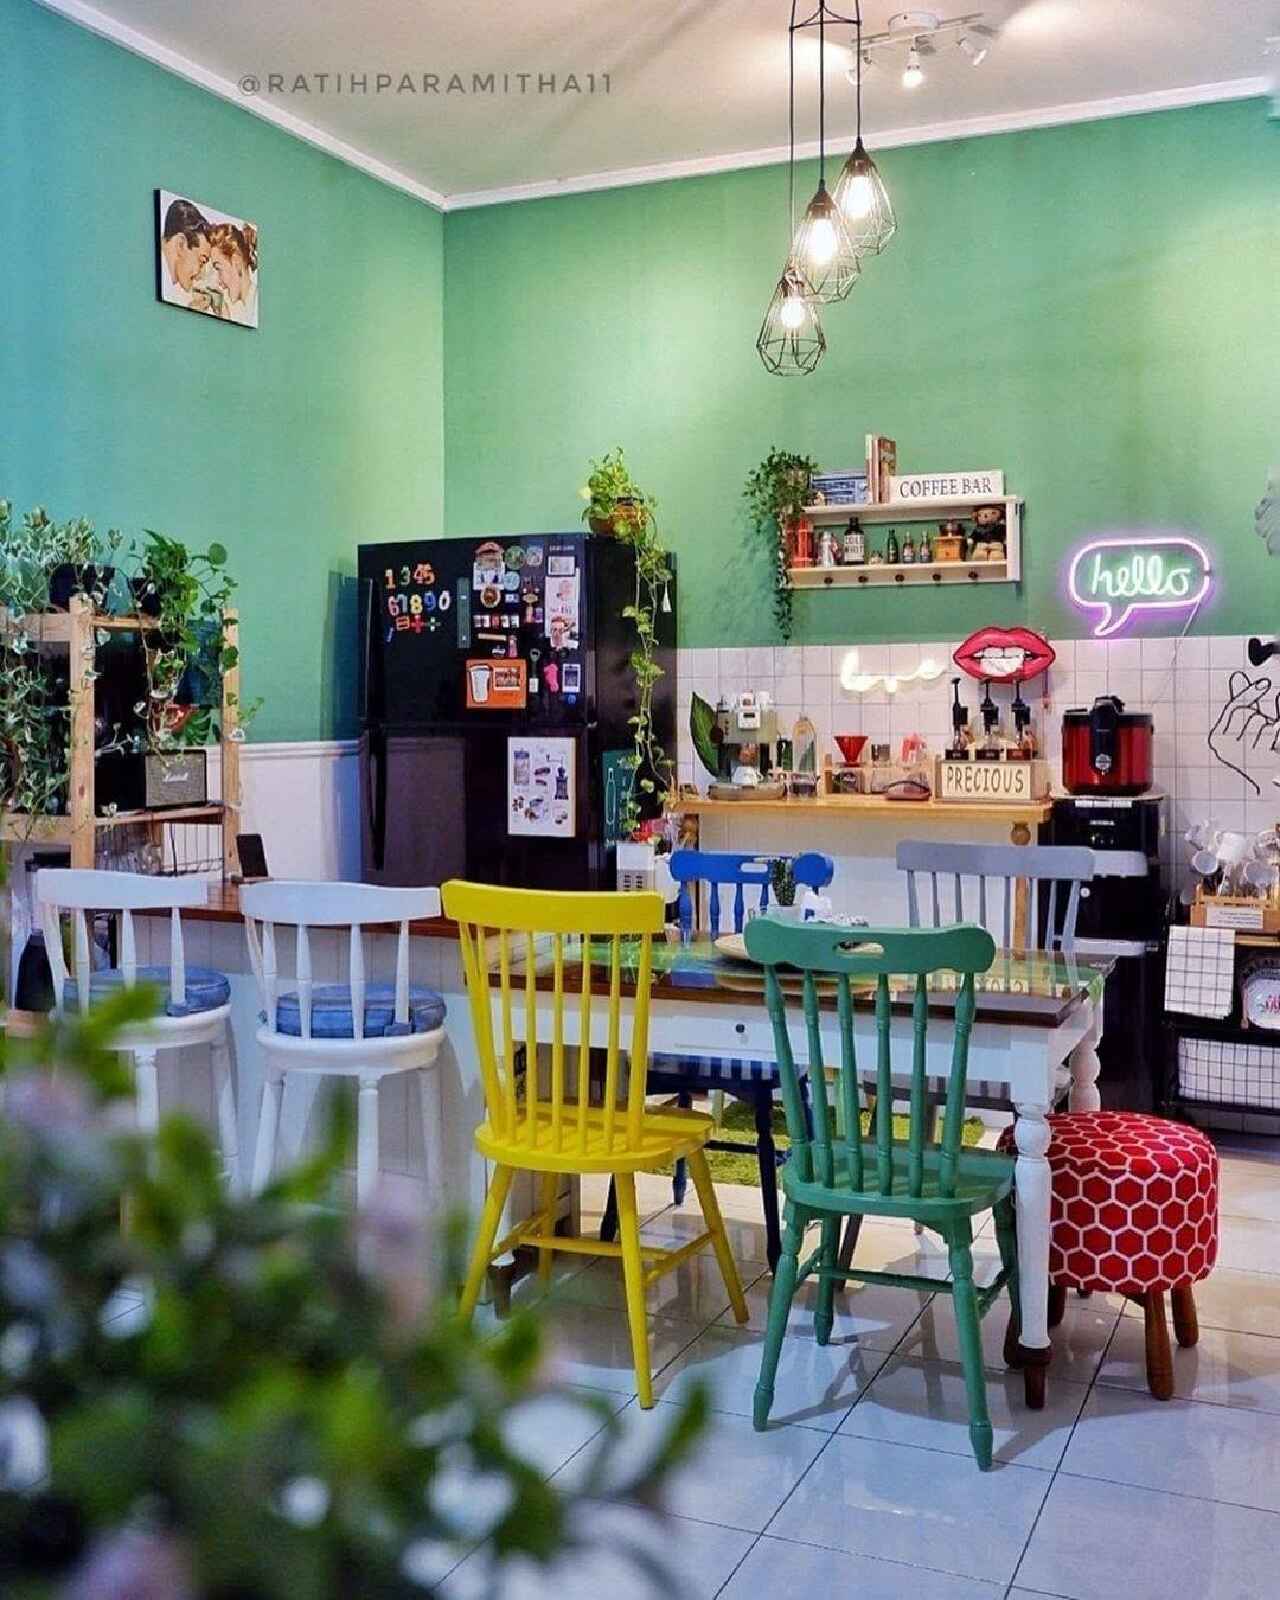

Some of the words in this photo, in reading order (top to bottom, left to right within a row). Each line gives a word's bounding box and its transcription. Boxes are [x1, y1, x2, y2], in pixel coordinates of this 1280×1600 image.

[900, 478, 958, 498] COFFEE
[961, 477, 993, 495] BAR
[1091, 552, 1191, 597] hello
[946, 765, 1024, 793] PRECIOUS
